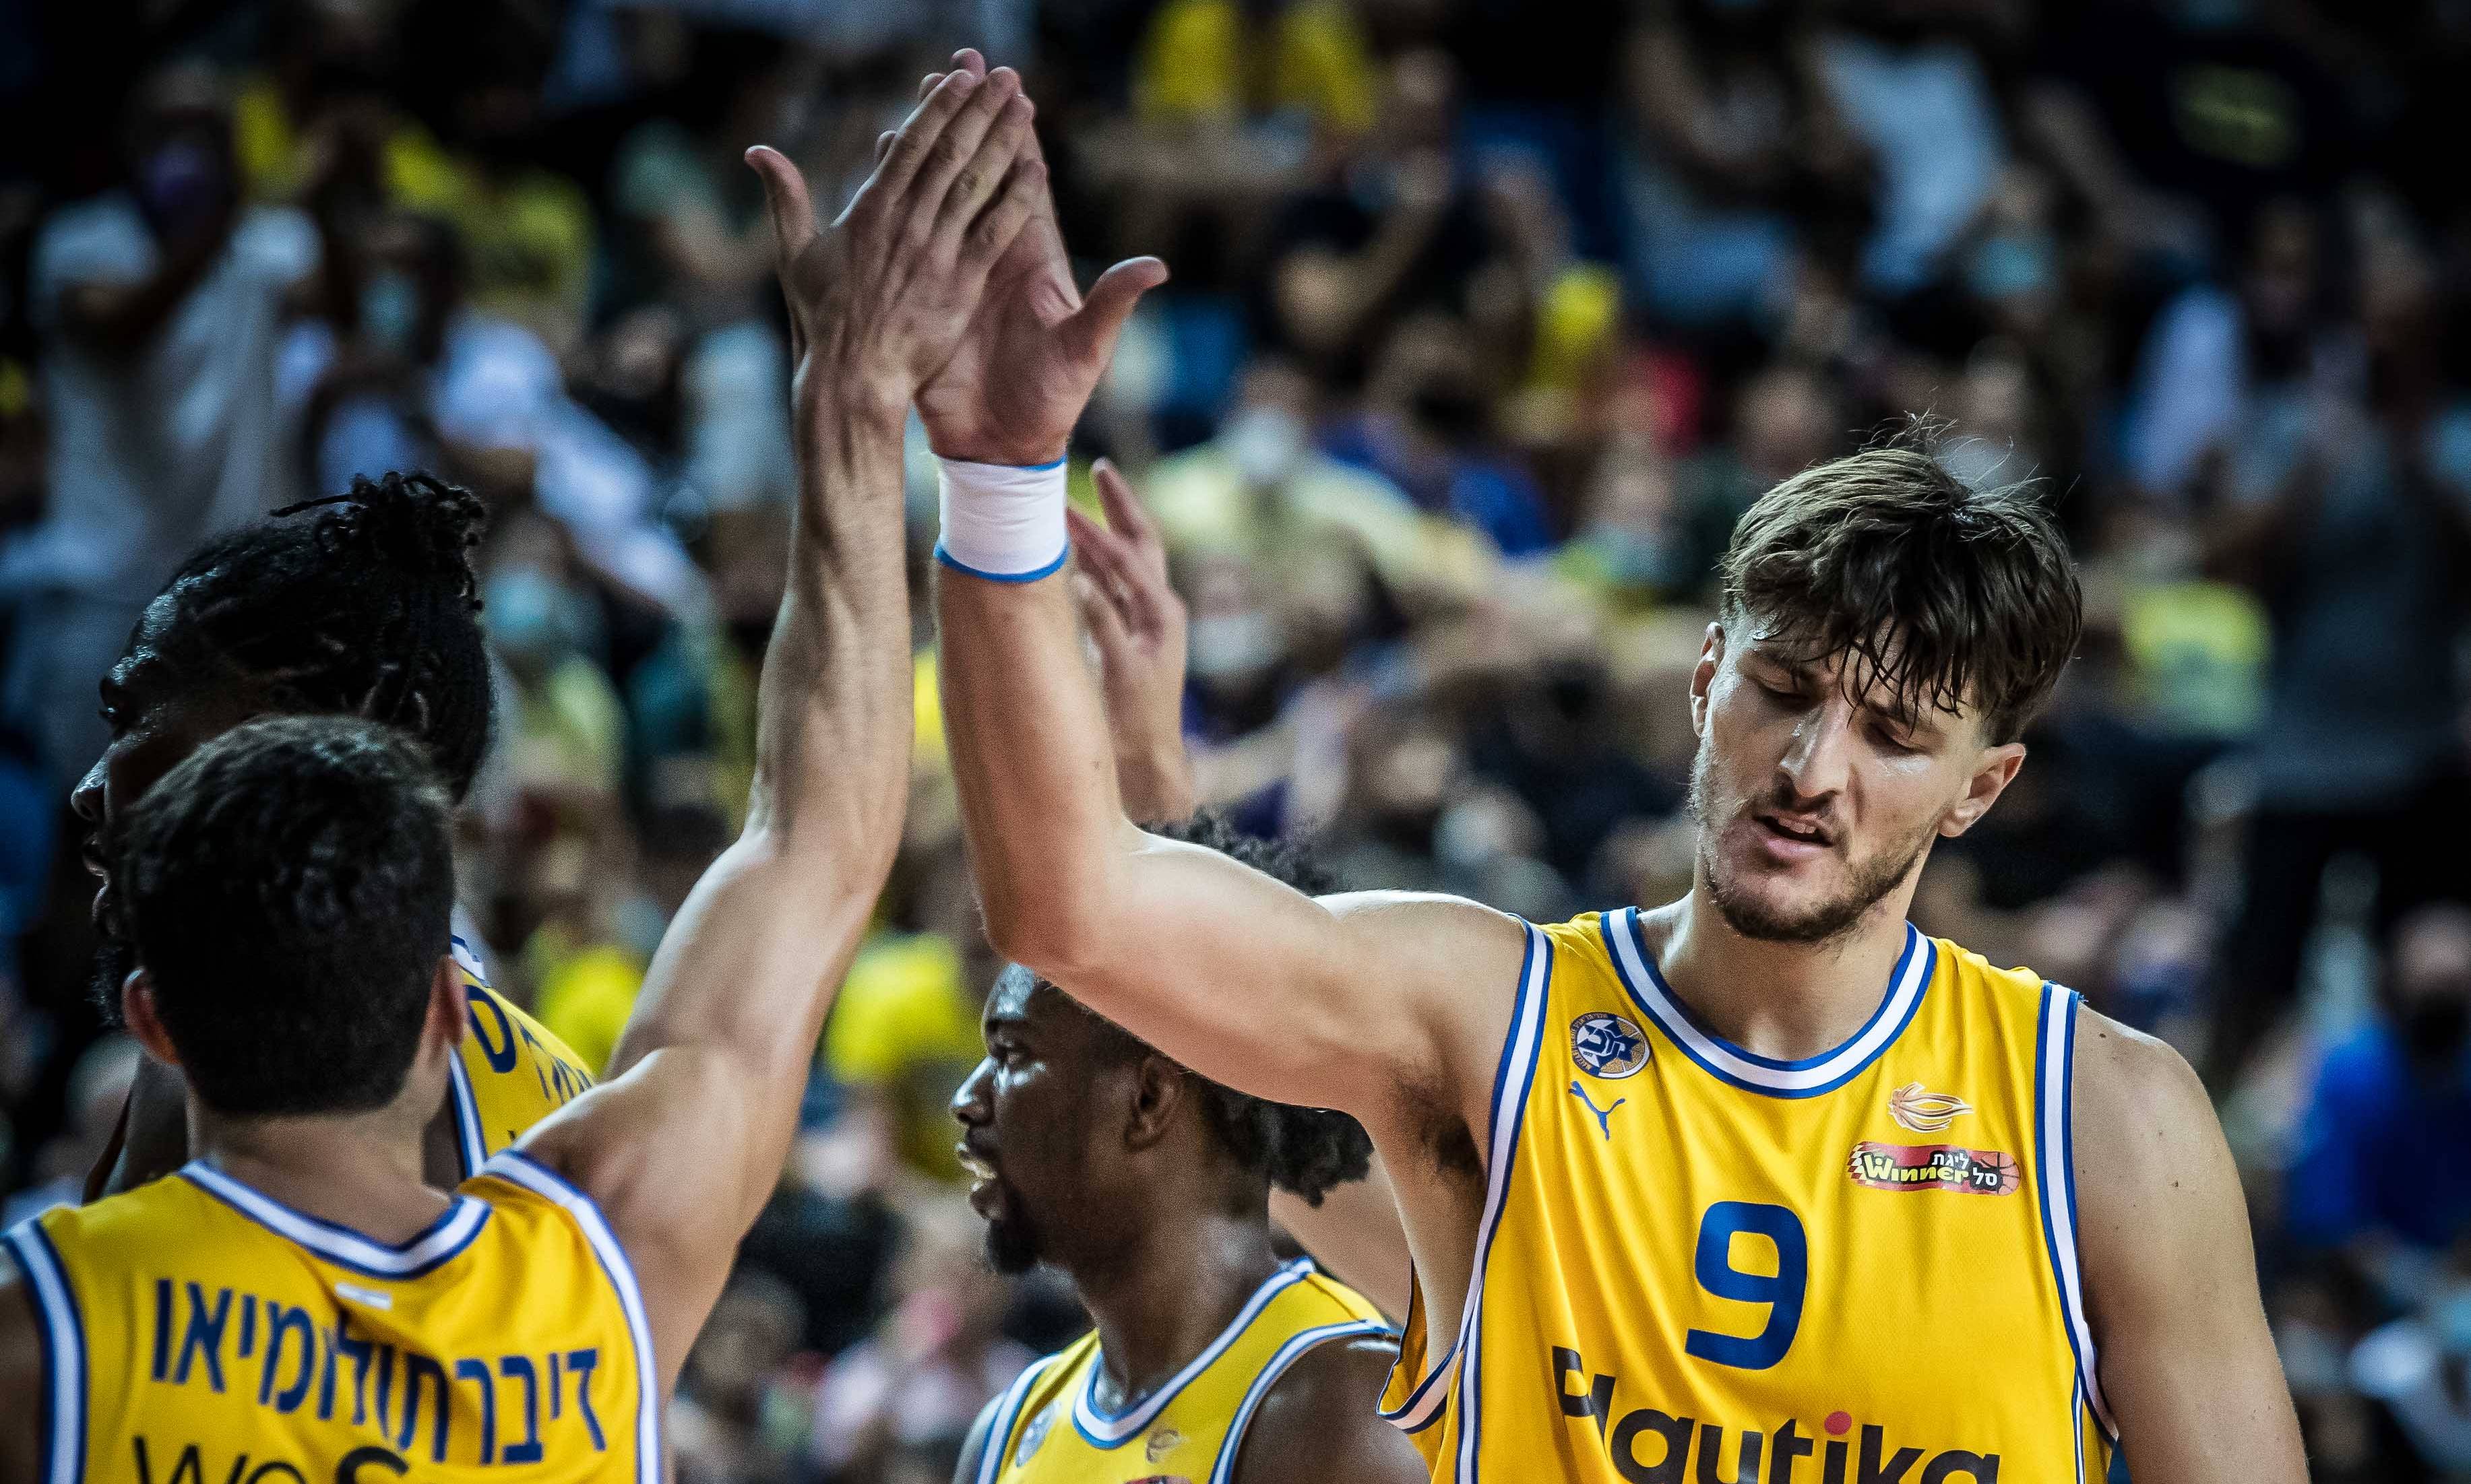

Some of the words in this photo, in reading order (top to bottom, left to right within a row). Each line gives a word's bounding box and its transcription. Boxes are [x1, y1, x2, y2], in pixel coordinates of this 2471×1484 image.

[1864, 1154, 1969, 1183] Winner
[1932, 1153, 1969, 1169] ליגת
[1972, 1167, 1997, 1186] סל
[1685, 1201, 1807, 1369] 9
